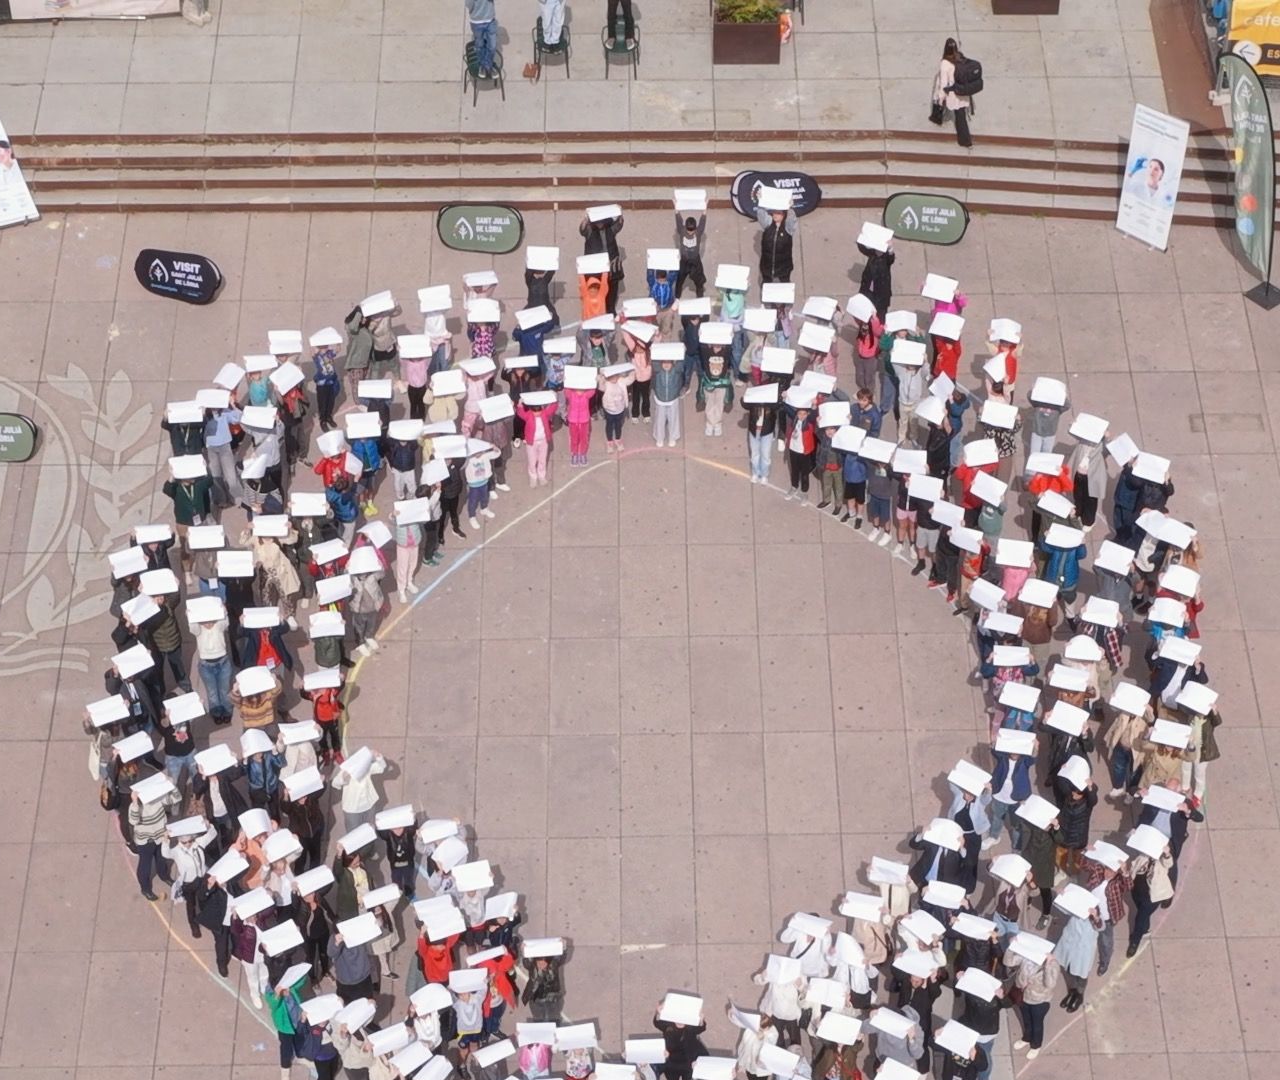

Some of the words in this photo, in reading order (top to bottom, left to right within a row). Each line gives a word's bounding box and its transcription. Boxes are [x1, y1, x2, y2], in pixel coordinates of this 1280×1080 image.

[773, 177, 801, 188] VISIT
[922, 206, 938, 215] SANT
[475, 217, 492, 225] SANT
[922, 215, 930, 223] DE
[475, 225, 484, 233] DE
[173, 260, 201, 274] VISIT
[171, 271, 187, 279] SANT
